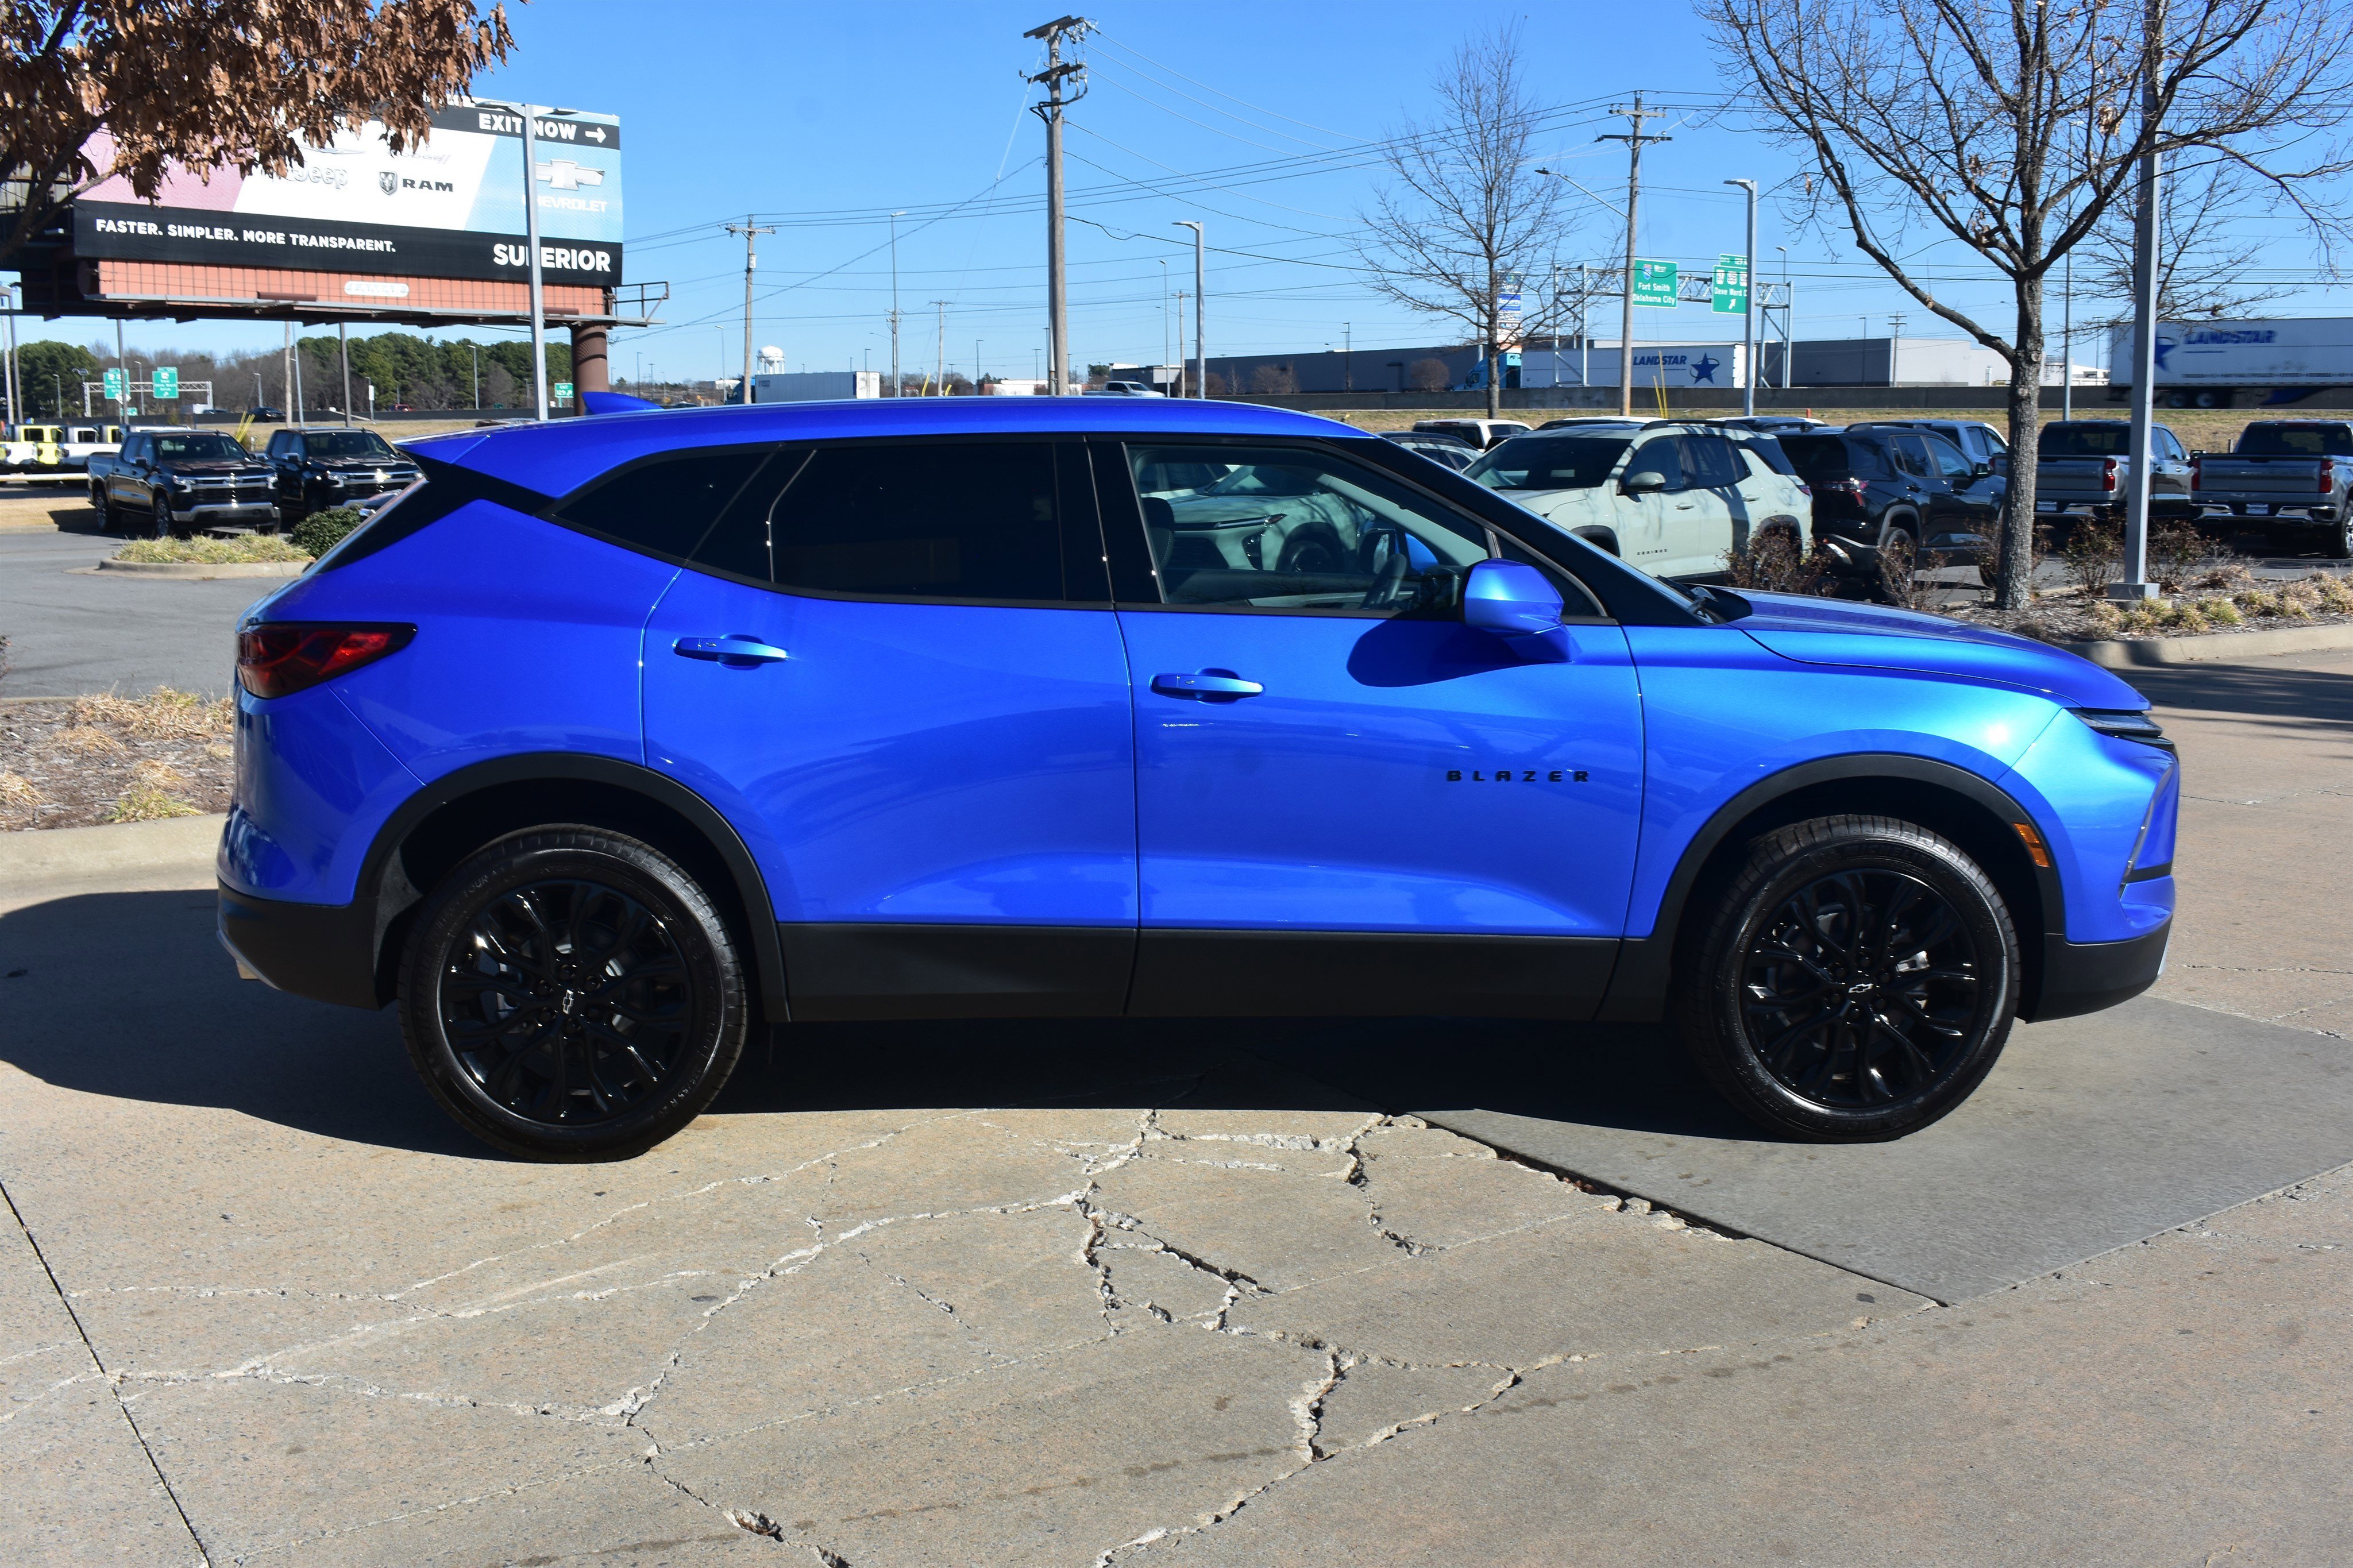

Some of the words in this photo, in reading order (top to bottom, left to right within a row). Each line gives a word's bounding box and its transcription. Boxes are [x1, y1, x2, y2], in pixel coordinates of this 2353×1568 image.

[479, 113, 523, 133] EXIT
[533, 119, 577, 140] NOW
[402, 179, 453, 192] RAM
[521, 194, 608, 212] HEVROLET
[96, 219, 163, 235] FASTER.
[167, 224, 239, 241] SIMPLER.
[243, 230, 286, 245] MORE
[289, 233, 396, 252] TRANSPARENT.
[493, 244, 611, 272] SUERIOR
[1638, 282, 1650, 291] Fort
[1653, 283, 1671, 292] Smith
[1714, 287, 1727, 295] Dave
[1632, 293, 1661, 303] Oklahoma
[1662, 295, 1675, 306] City
[1633, 356, 1687, 365] LANDSTAR
[1446, 770, 1589, 782] BLAZER
